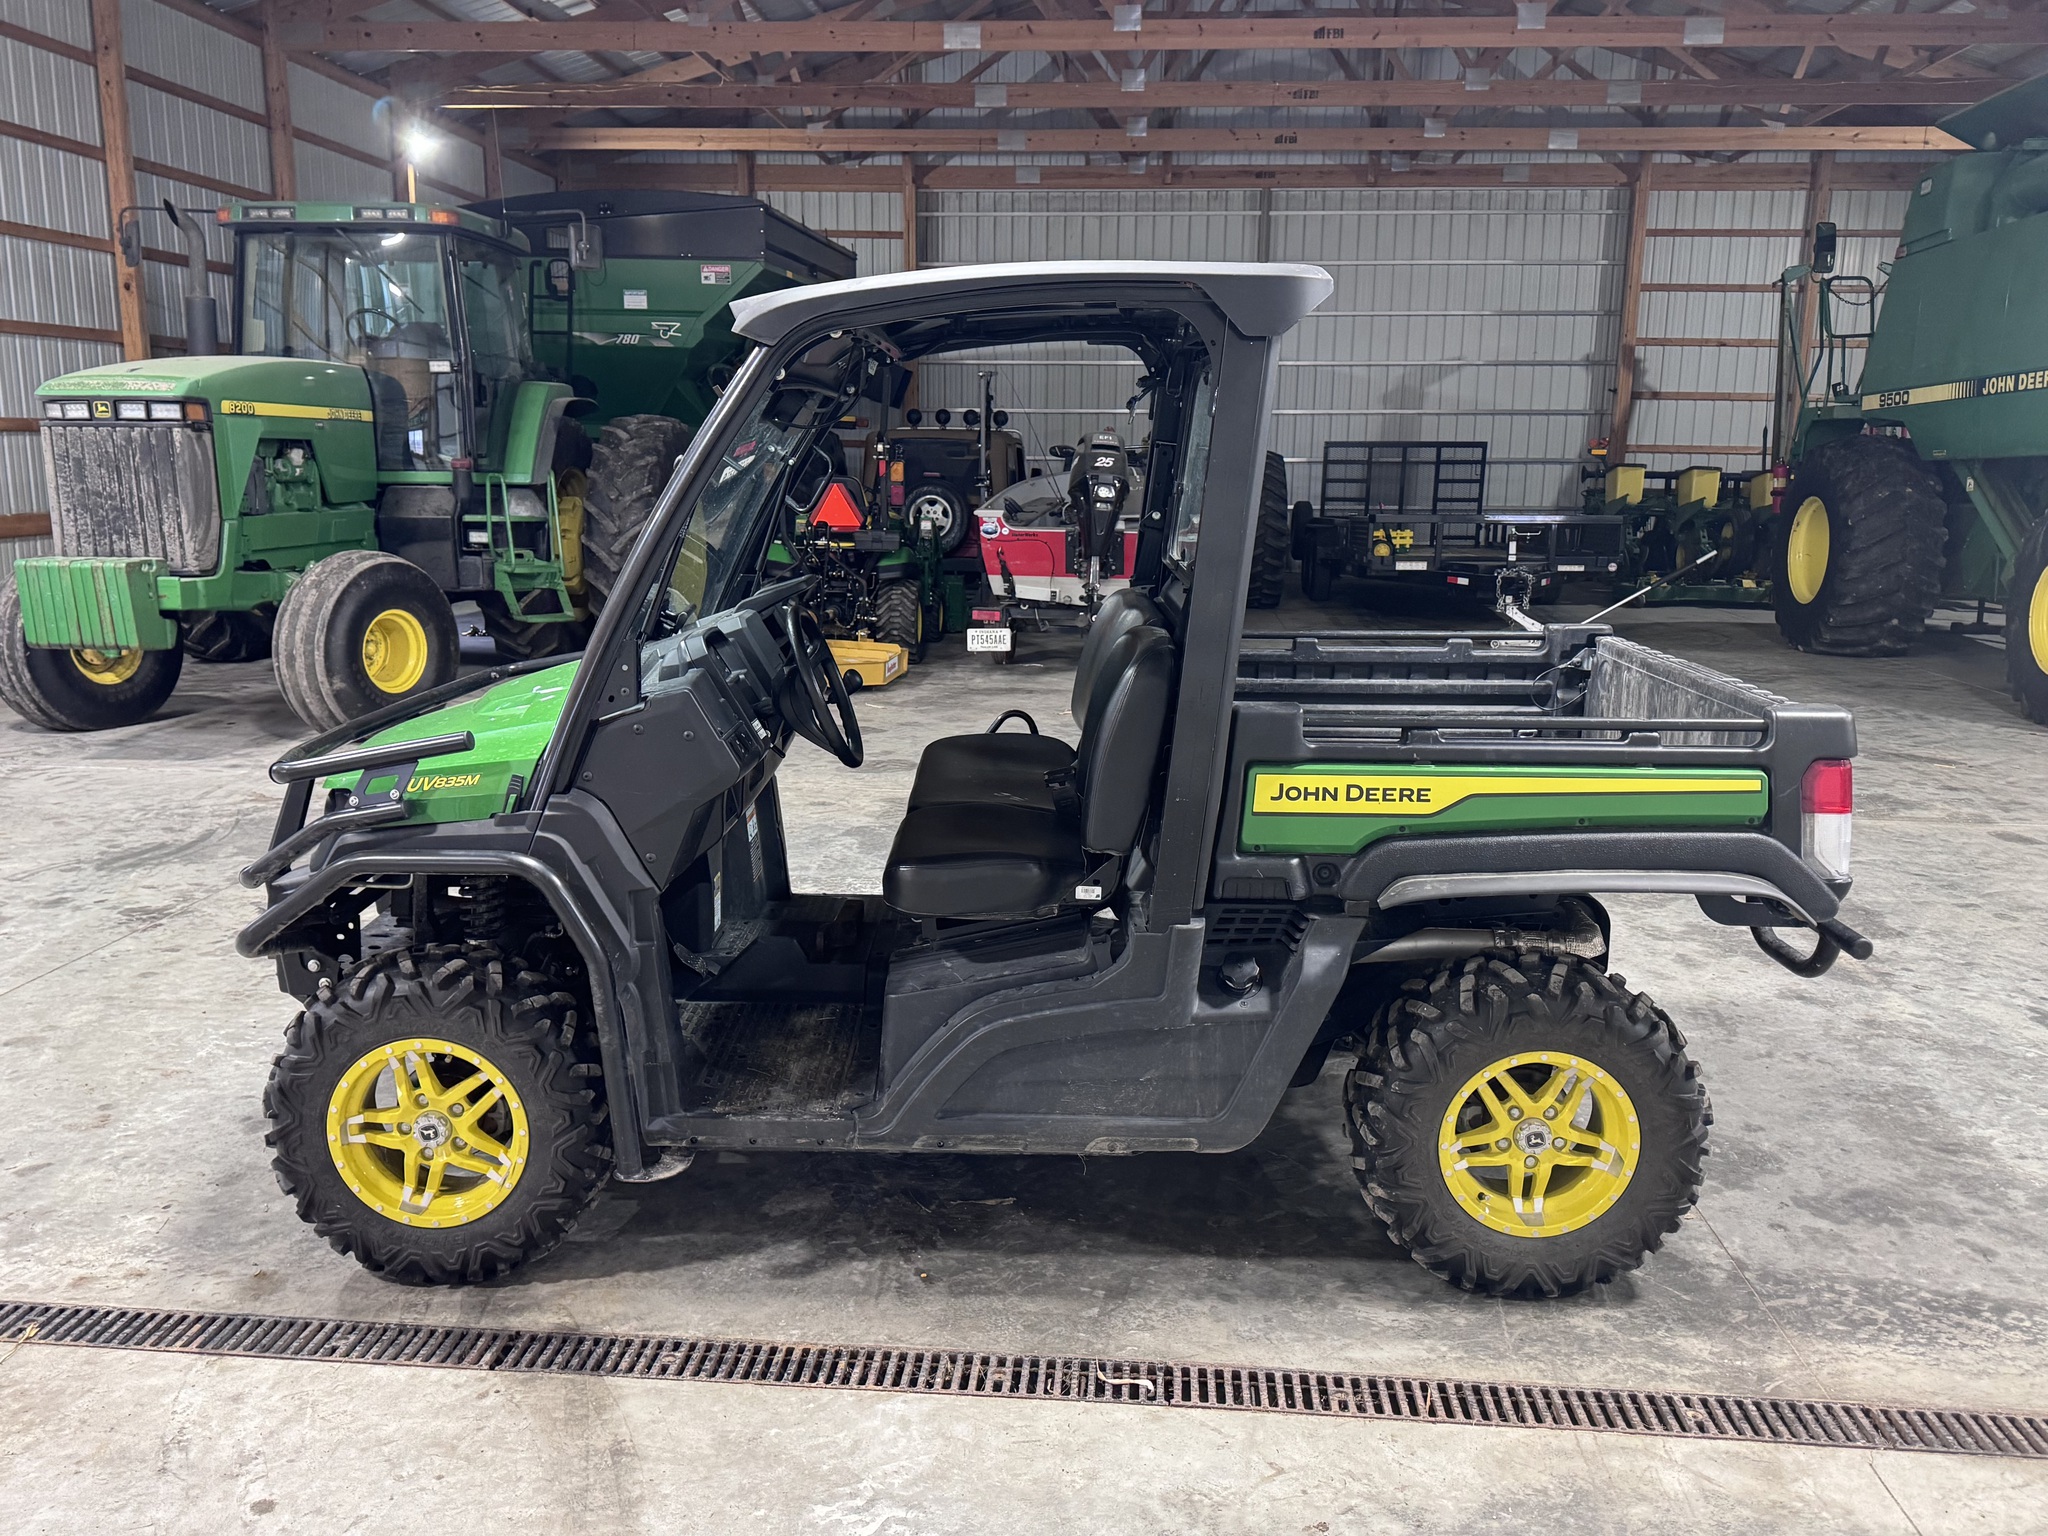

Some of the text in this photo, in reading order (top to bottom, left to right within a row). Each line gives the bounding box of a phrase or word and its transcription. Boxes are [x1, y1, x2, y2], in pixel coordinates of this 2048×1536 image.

[1326, 28, 1344, 39] FBI
[1283, 135, 1297, 144] FBI
[616, 334, 640, 344] 780
[1982, 375, 2015, 396] JOHN
[1879, 391, 1910, 407] 9500
[229, 401, 255, 415] 8200
[327, 408, 362, 420] JOHN DEERE
[1094, 456, 1115, 467] 25
[406, 774, 481, 792] UV835M
[1270, 783, 1432, 803] JOHN DEERE
